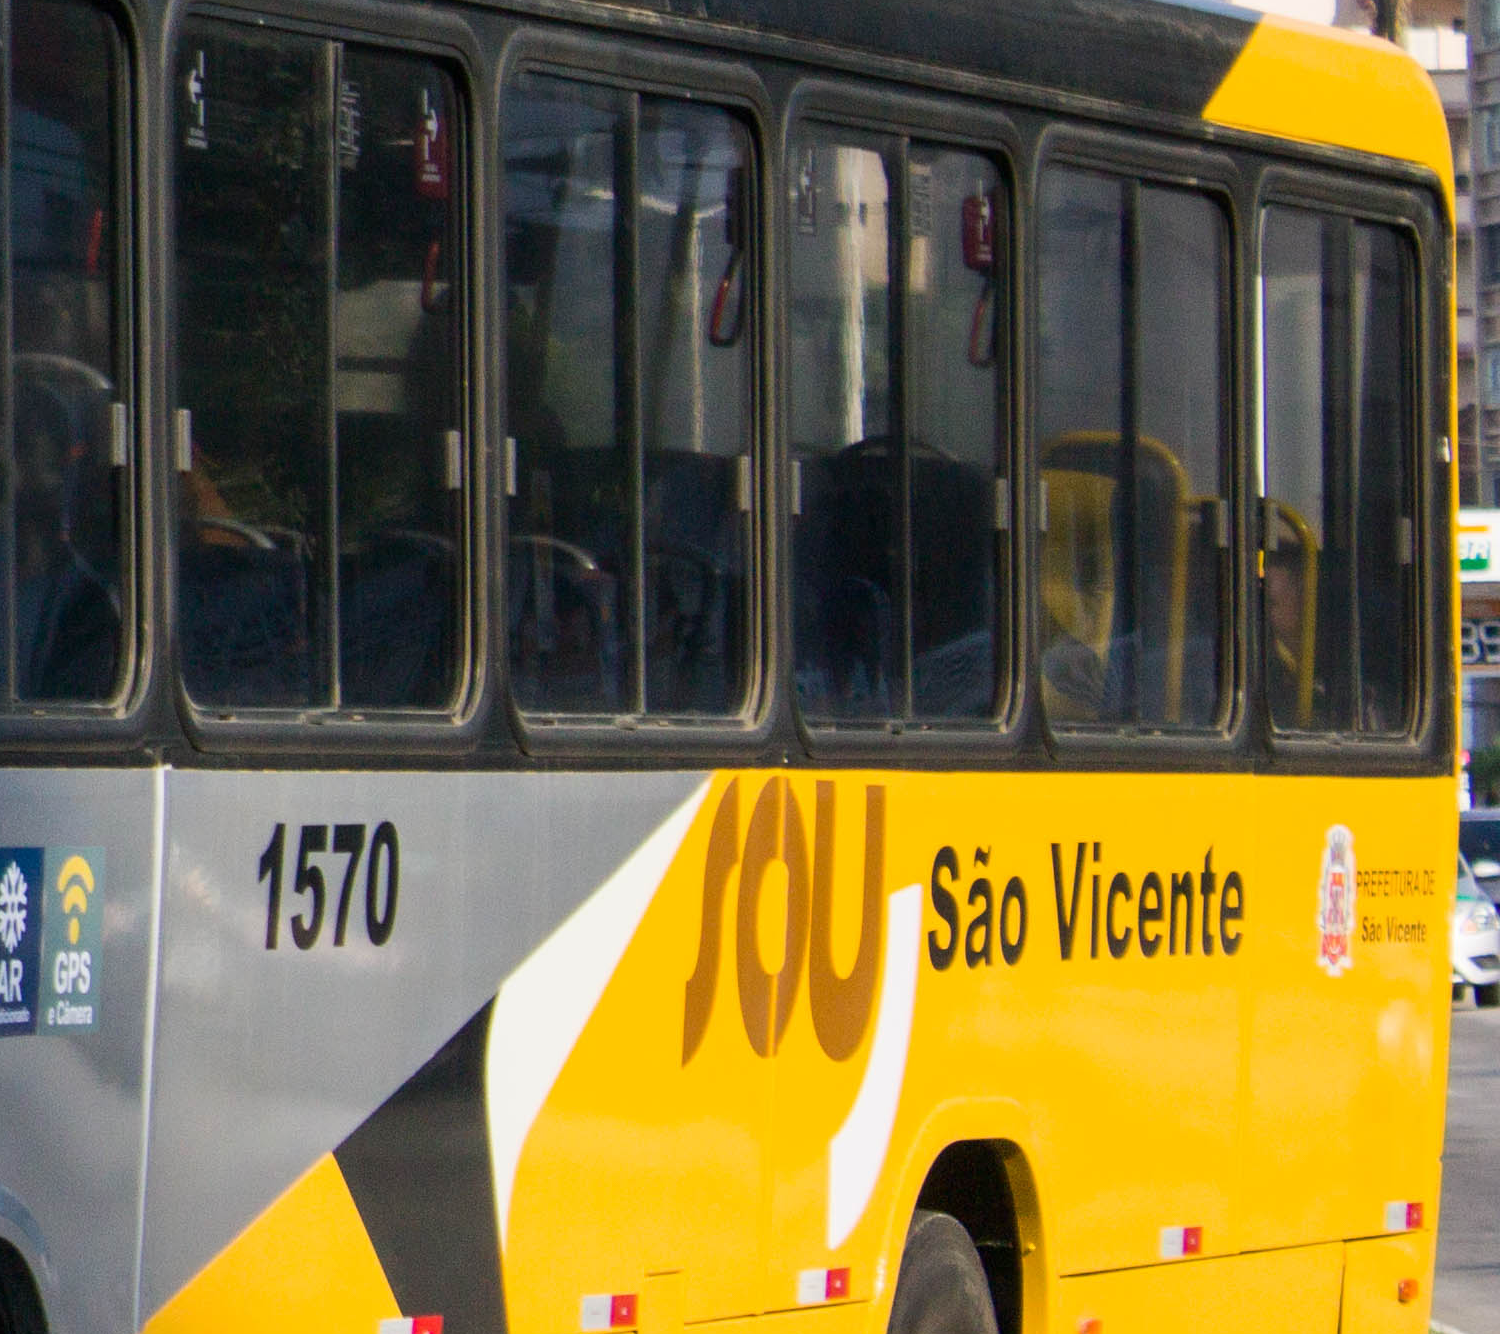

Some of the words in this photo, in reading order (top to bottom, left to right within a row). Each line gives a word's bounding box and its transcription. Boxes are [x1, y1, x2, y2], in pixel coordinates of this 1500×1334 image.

[258, 821, 400, 950] 1570
[927, 845, 1027, 971] São
[1051, 841, 1245, 961] Vicente
[1357, 869, 1420, 897] PREFEITURA
[54, 951, 92, 994] GPS
